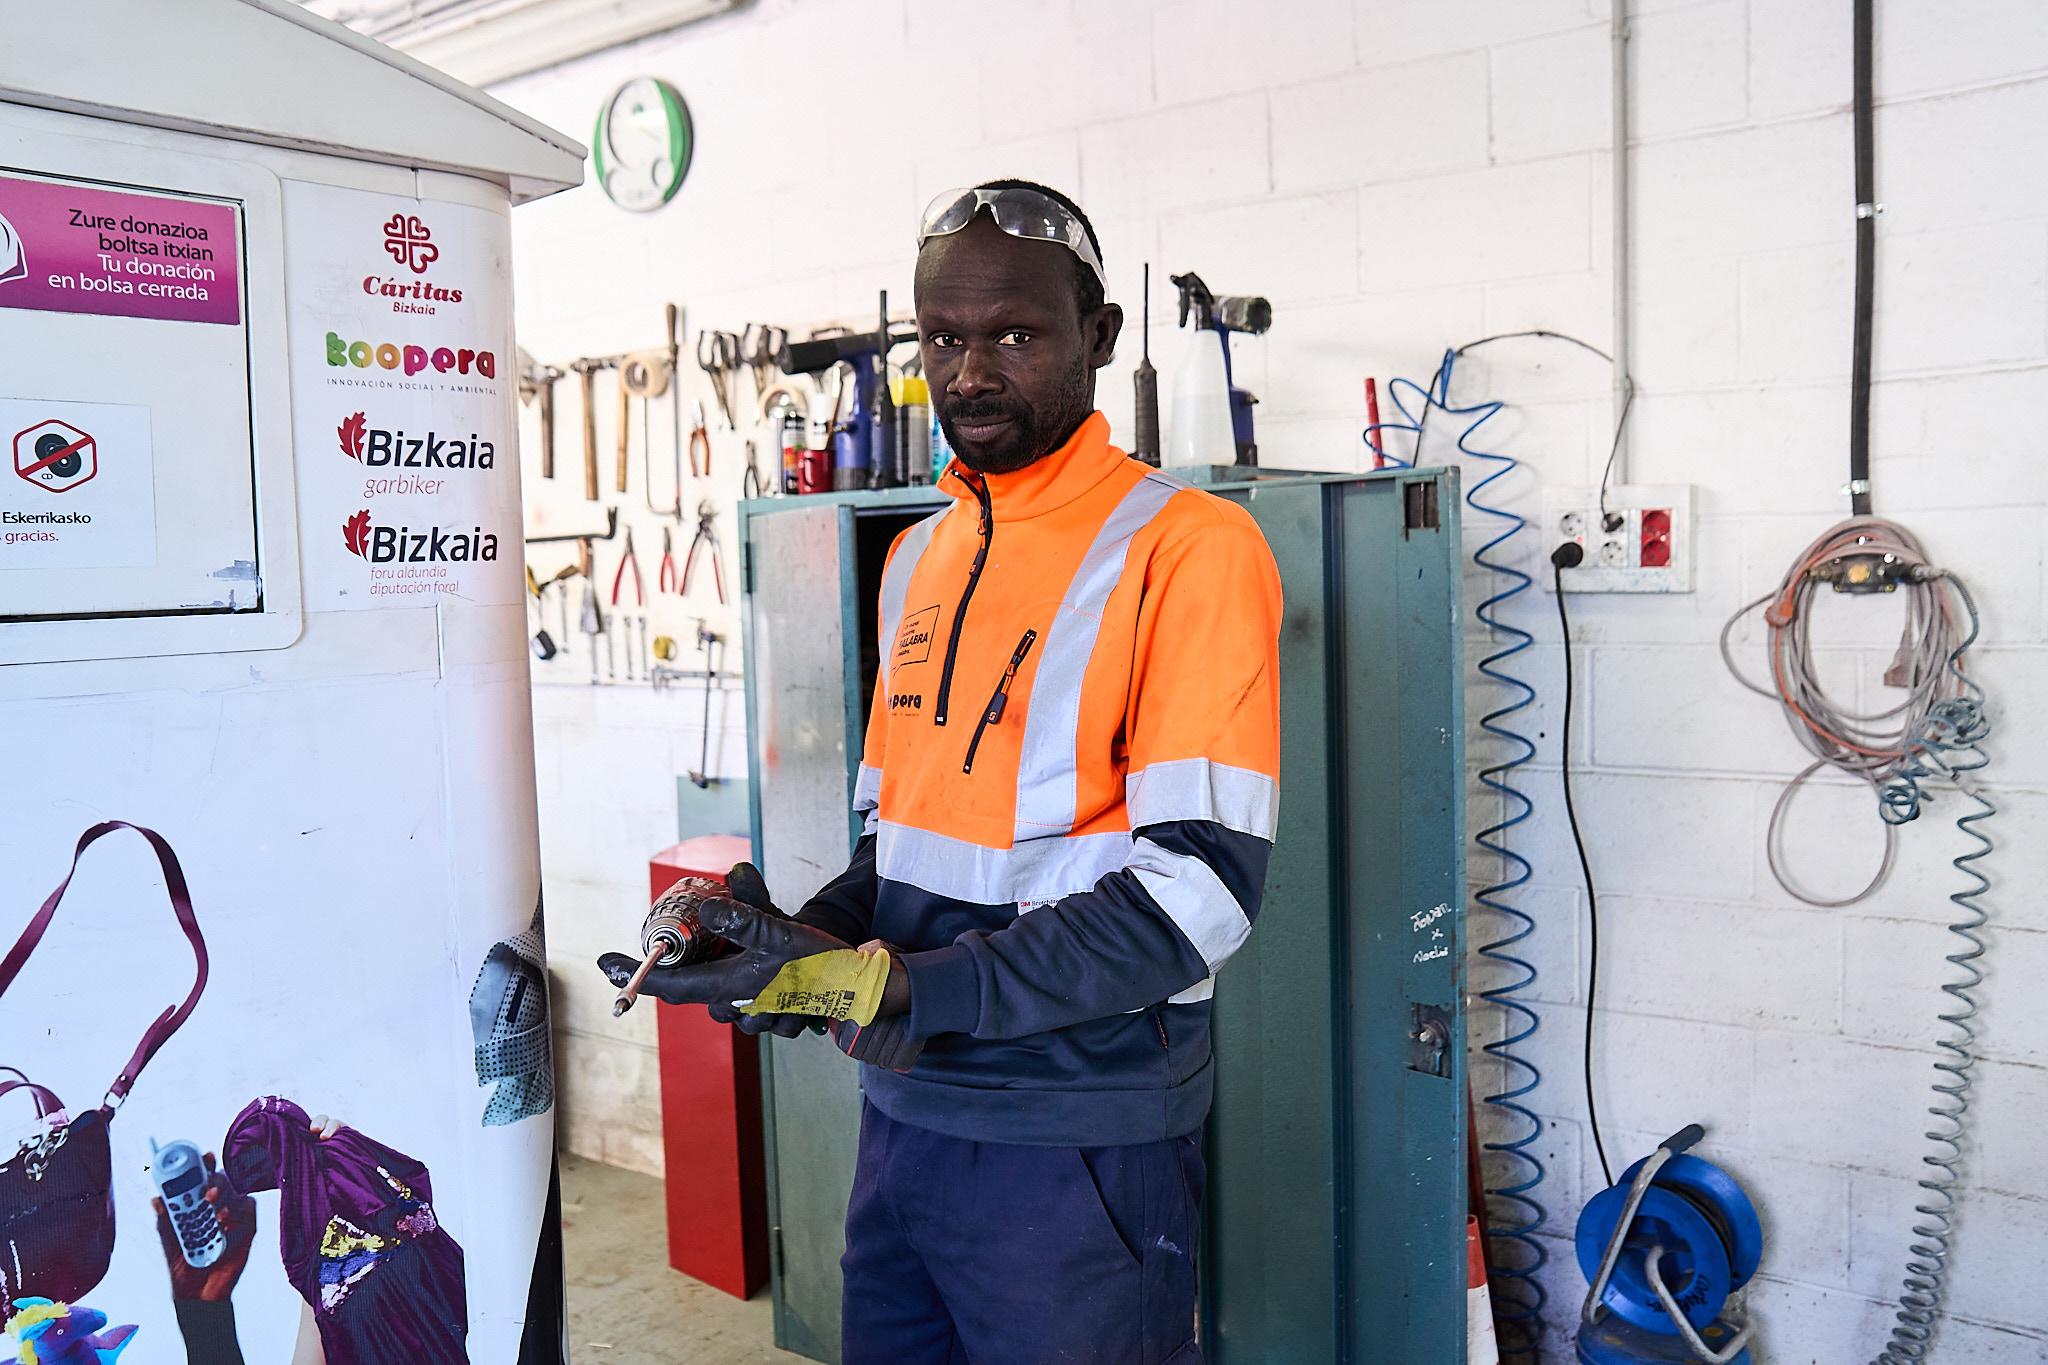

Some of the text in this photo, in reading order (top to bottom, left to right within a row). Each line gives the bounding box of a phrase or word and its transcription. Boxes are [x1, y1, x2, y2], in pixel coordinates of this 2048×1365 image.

[69, 208, 209, 241] Zure donazioa
[99, 233, 214, 262] boltsa itxian
[97, 253, 216, 282] Tu donación
[48, 273, 209, 301] en bolsa cerrada
[363, 276, 463, 303] Cáritas
[393, 301, 436, 315] Bizkaia
[326, 331, 496, 380] koopera
[327, 378, 393, 389] INNOVACIÓN
[399, 382, 434, 392] SOCIAL
[451, 385, 497, 396] AMBIENTAL
[366, 429, 495, 469] Bizkaia
[363, 474, 445, 498] garbiker
[2, 512, 92, 524] Eskerrikasko
[5, 530, 59, 545] gracias.
[371, 526, 498, 563] Bizkaia
[370, 566, 447, 581] foru aldundia
[369, 580, 460, 597] diputación foral
